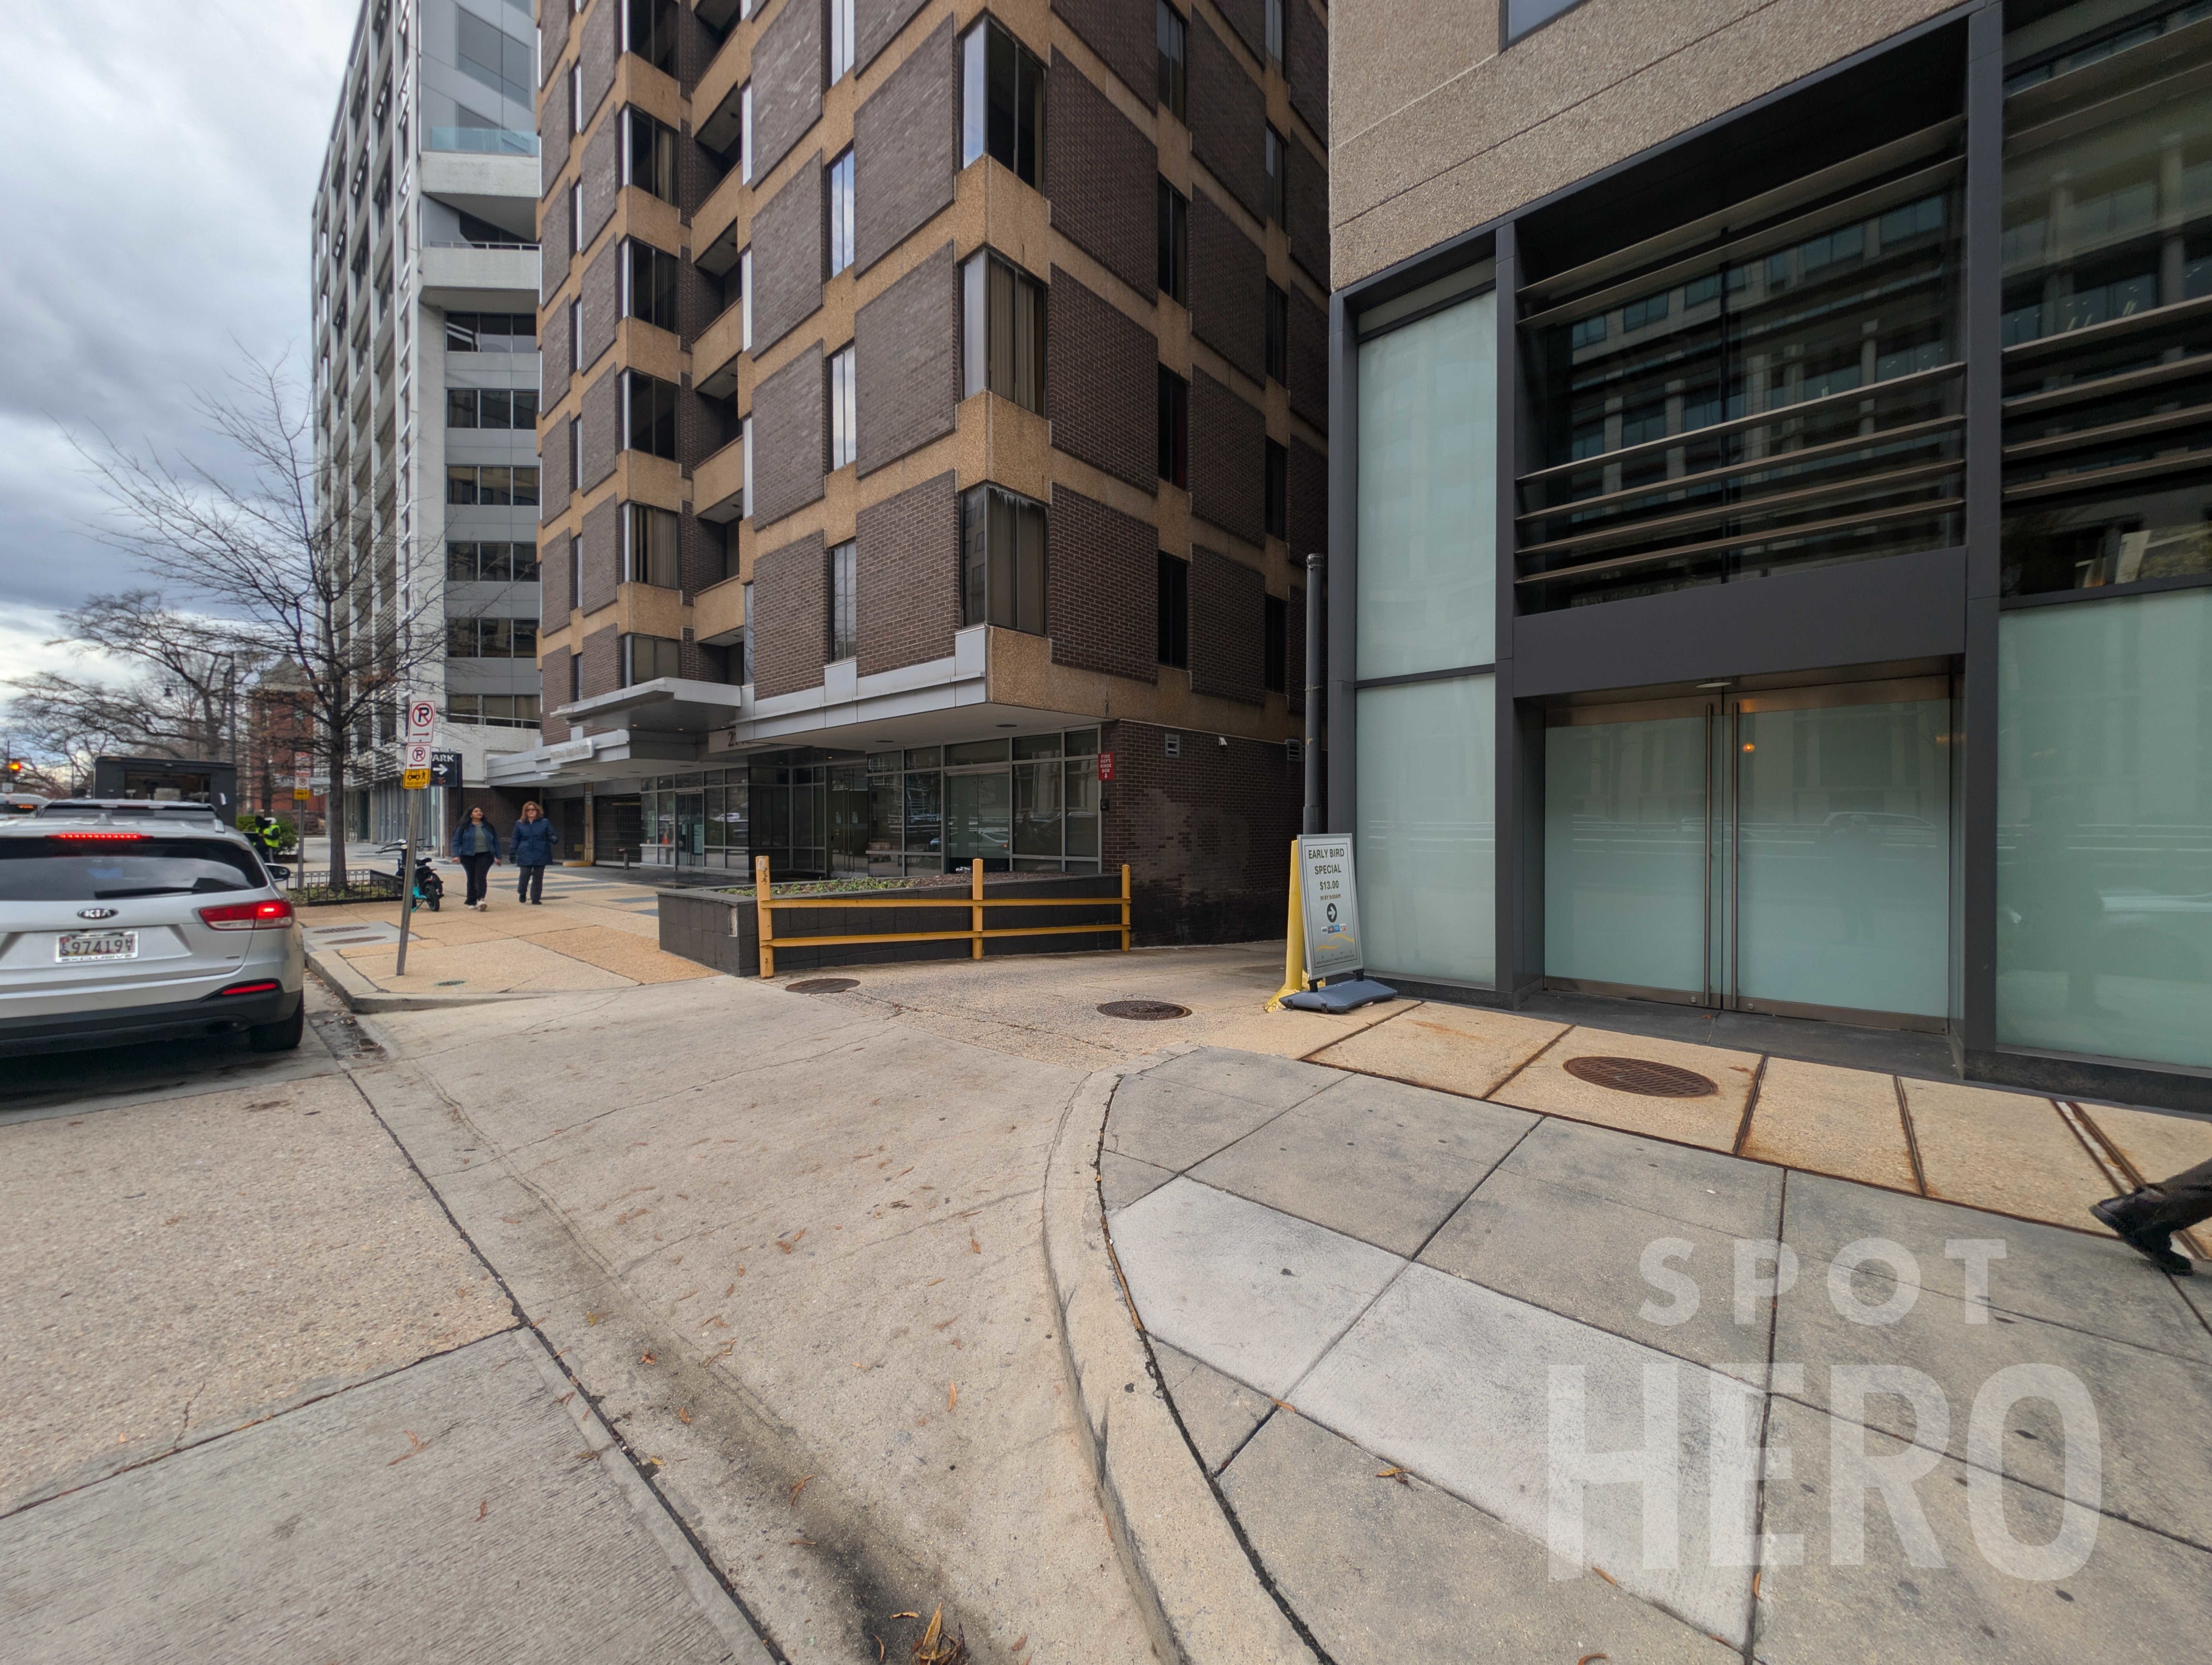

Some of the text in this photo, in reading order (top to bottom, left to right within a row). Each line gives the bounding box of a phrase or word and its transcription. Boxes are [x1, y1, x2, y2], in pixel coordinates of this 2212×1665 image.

[431, 754, 454, 763] ARK
[1308, 848, 1344, 859] EARLY BIRD
[1314, 864, 1342, 875] SPECIAL
[1319, 880, 1339, 892] $13.00
[85, 909, 111, 917] KIA
[71, 939, 123, 955] 97419
